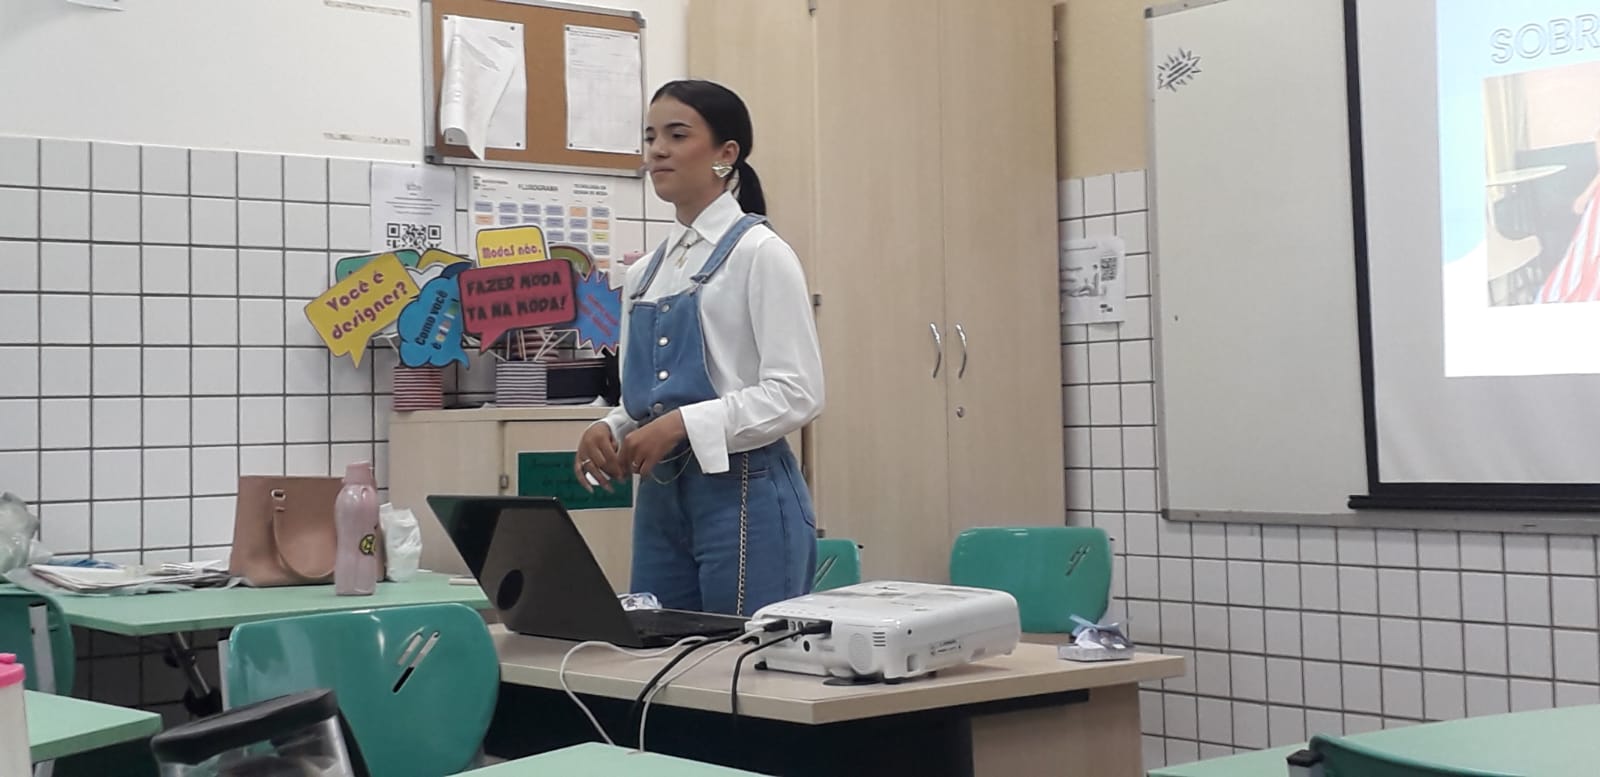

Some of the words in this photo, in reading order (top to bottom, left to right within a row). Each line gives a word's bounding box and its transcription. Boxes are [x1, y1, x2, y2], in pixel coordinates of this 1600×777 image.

[482, 244, 515, 259] Modas
[326, 280, 369, 312] Você
[373, 269, 384, 284] é
[467, 275, 515, 296] FAZER
[520, 271, 562, 289] MODA
[332, 281, 408, 340] designer?
[491, 301, 513, 317] NA
[517, 296, 566, 316] MODA!
